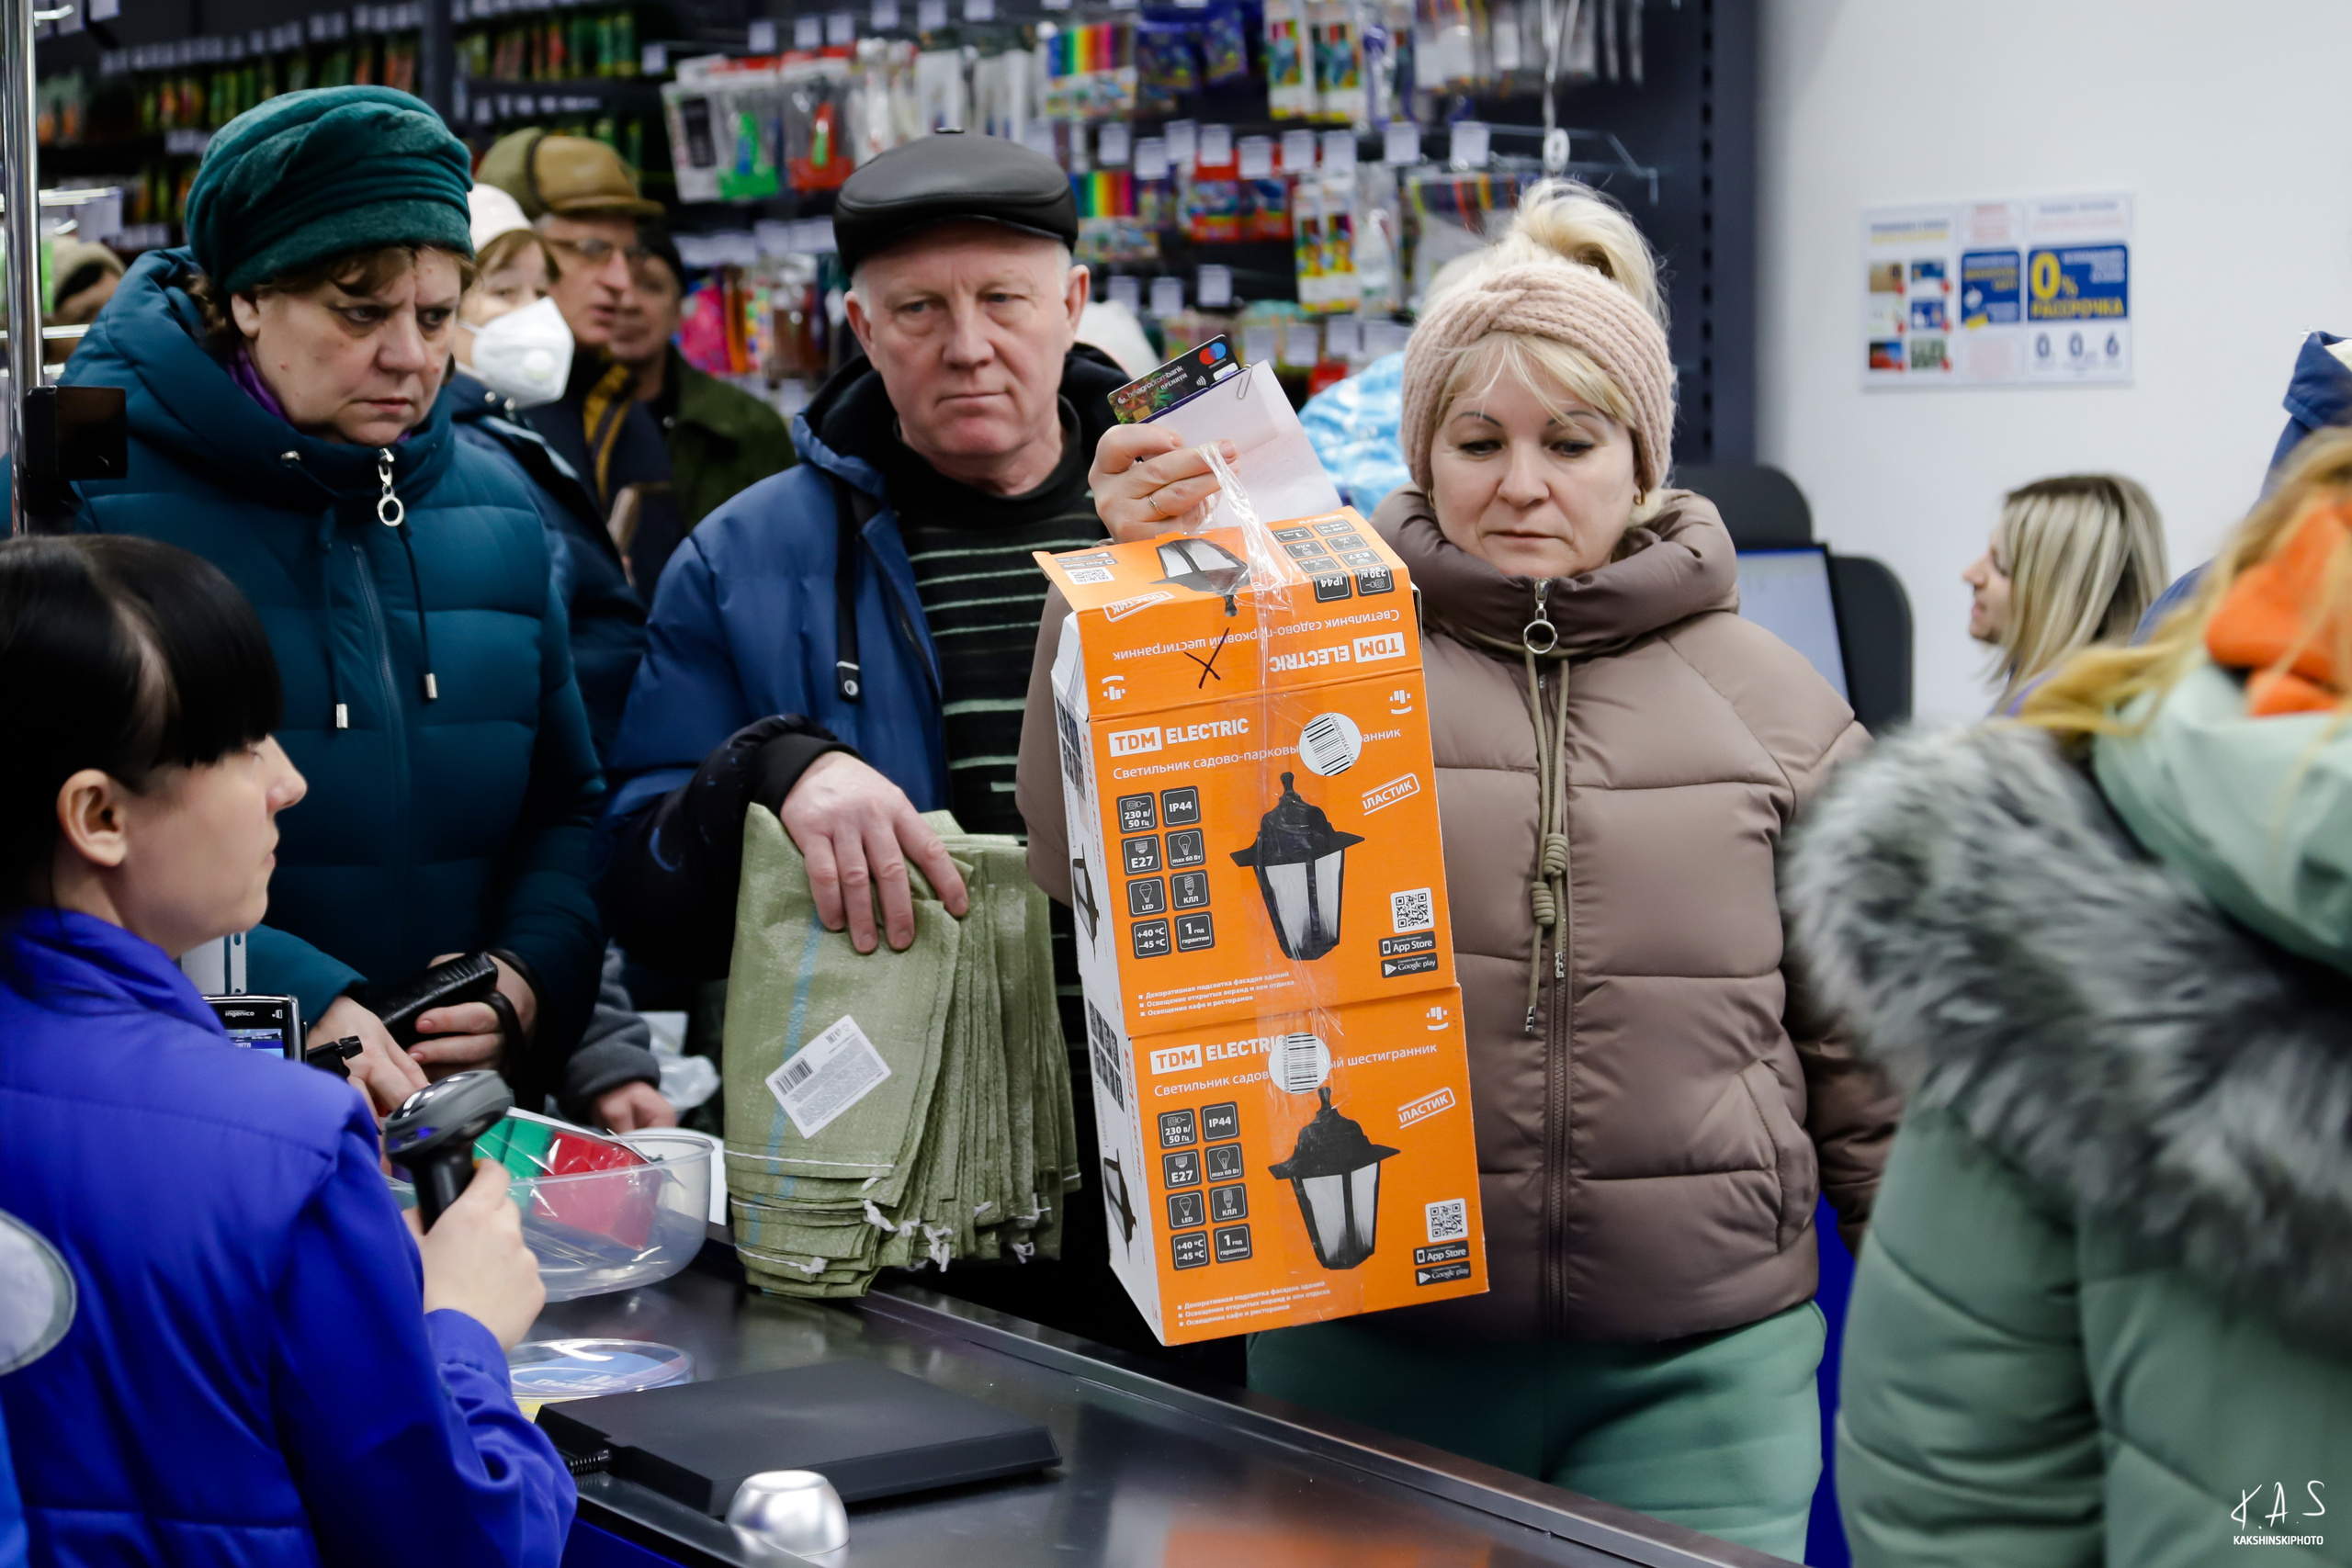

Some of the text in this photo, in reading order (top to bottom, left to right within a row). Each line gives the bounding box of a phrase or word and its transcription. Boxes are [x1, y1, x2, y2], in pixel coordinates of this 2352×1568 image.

[1126, 365, 1184, 399] belagroprombank
[1160, 373, 1189, 390] ПРЕМИУМ
[1320, 576, 1343, 588] IP44
[1111, 593, 1164, 615] ПЛАСТИК
[1325, 609, 1400, 628] Светильник
[1113, 638, 1206, 660] шестигранник
[1269, 637, 1401, 672] TDM ELECTRIC
[1114, 717, 1250, 752] TDM ELECTRIC
[1113, 744, 1299, 780] Светильник садово-парковы
[1125, 808, 1151, 820] 230 в/
[1169, 801, 1193, 813] IP44
[1128, 819, 1140, 828] 50
[1131, 856, 1154, 868] E27
[1183, 896, 1199, 904] КЛЛ
[1136, 929, 1154, 939] +40
[1185, 922, 1193, 935] 1
[1182, 935, 1210, 945] гарантии
[1393, 942, 1410, 953] App
[1411, 939, 1432, 949] Store
[1397, 961, 1421, 971] Google
[1422, 959, 1436, 968] play
[1146, 970, 1290, 999] Декоративная подсветка фасадов зданий
[1147, 997, 1186, 1008] Освещение
[1187, 990, 1223, 1002] открытых
[1223, 987, 1250, 997] веранд
[1269, 980, 1295, 990] отдыха
[1148, 1005, 1187, 1017] Освещение
[1188, 1000, 1206, 1010] кафе
[1213, 994, 1254, 1008] ресторанов
[1155, 1048, 1197, 1070] TDM
[1154, 1077, 1230, 1098] Светильник
[1347, 1044, 1438, 1066] шестигранник
[1208, 1116, 1232, 1128] IP44
[1165, 1124, 1192, 1136] 230 в/
[1169, 1134, 1181, 1144] 50
[1170, 1169, 1193, 1183] E27
[1222, 1208, 1238, 1216] КЛЛ
[1176, 1242, 1193, 1251] +40
[1224, 1235, 1231, 1247] 1
[1427, 1252, 1444, 1262] App
[1444, 1248, 1467, 1258] Store
[1184, 1280, 1326, 1310] Декоративная подсветка фасадов зданий
[1185, 1306, 1225, 1318] Освещение
[1225, 1301, 1261, 1312] открытых
[1261, 1295, 1286, 1306] веранд
[1305, 1288, 1331, 1298] отдыха
[1185, 1314, 1226, 1326] Освещение
[1226, 1310, 1244, 1320] кафе
[1250, 1303, 1291, 1317] ресторанов
